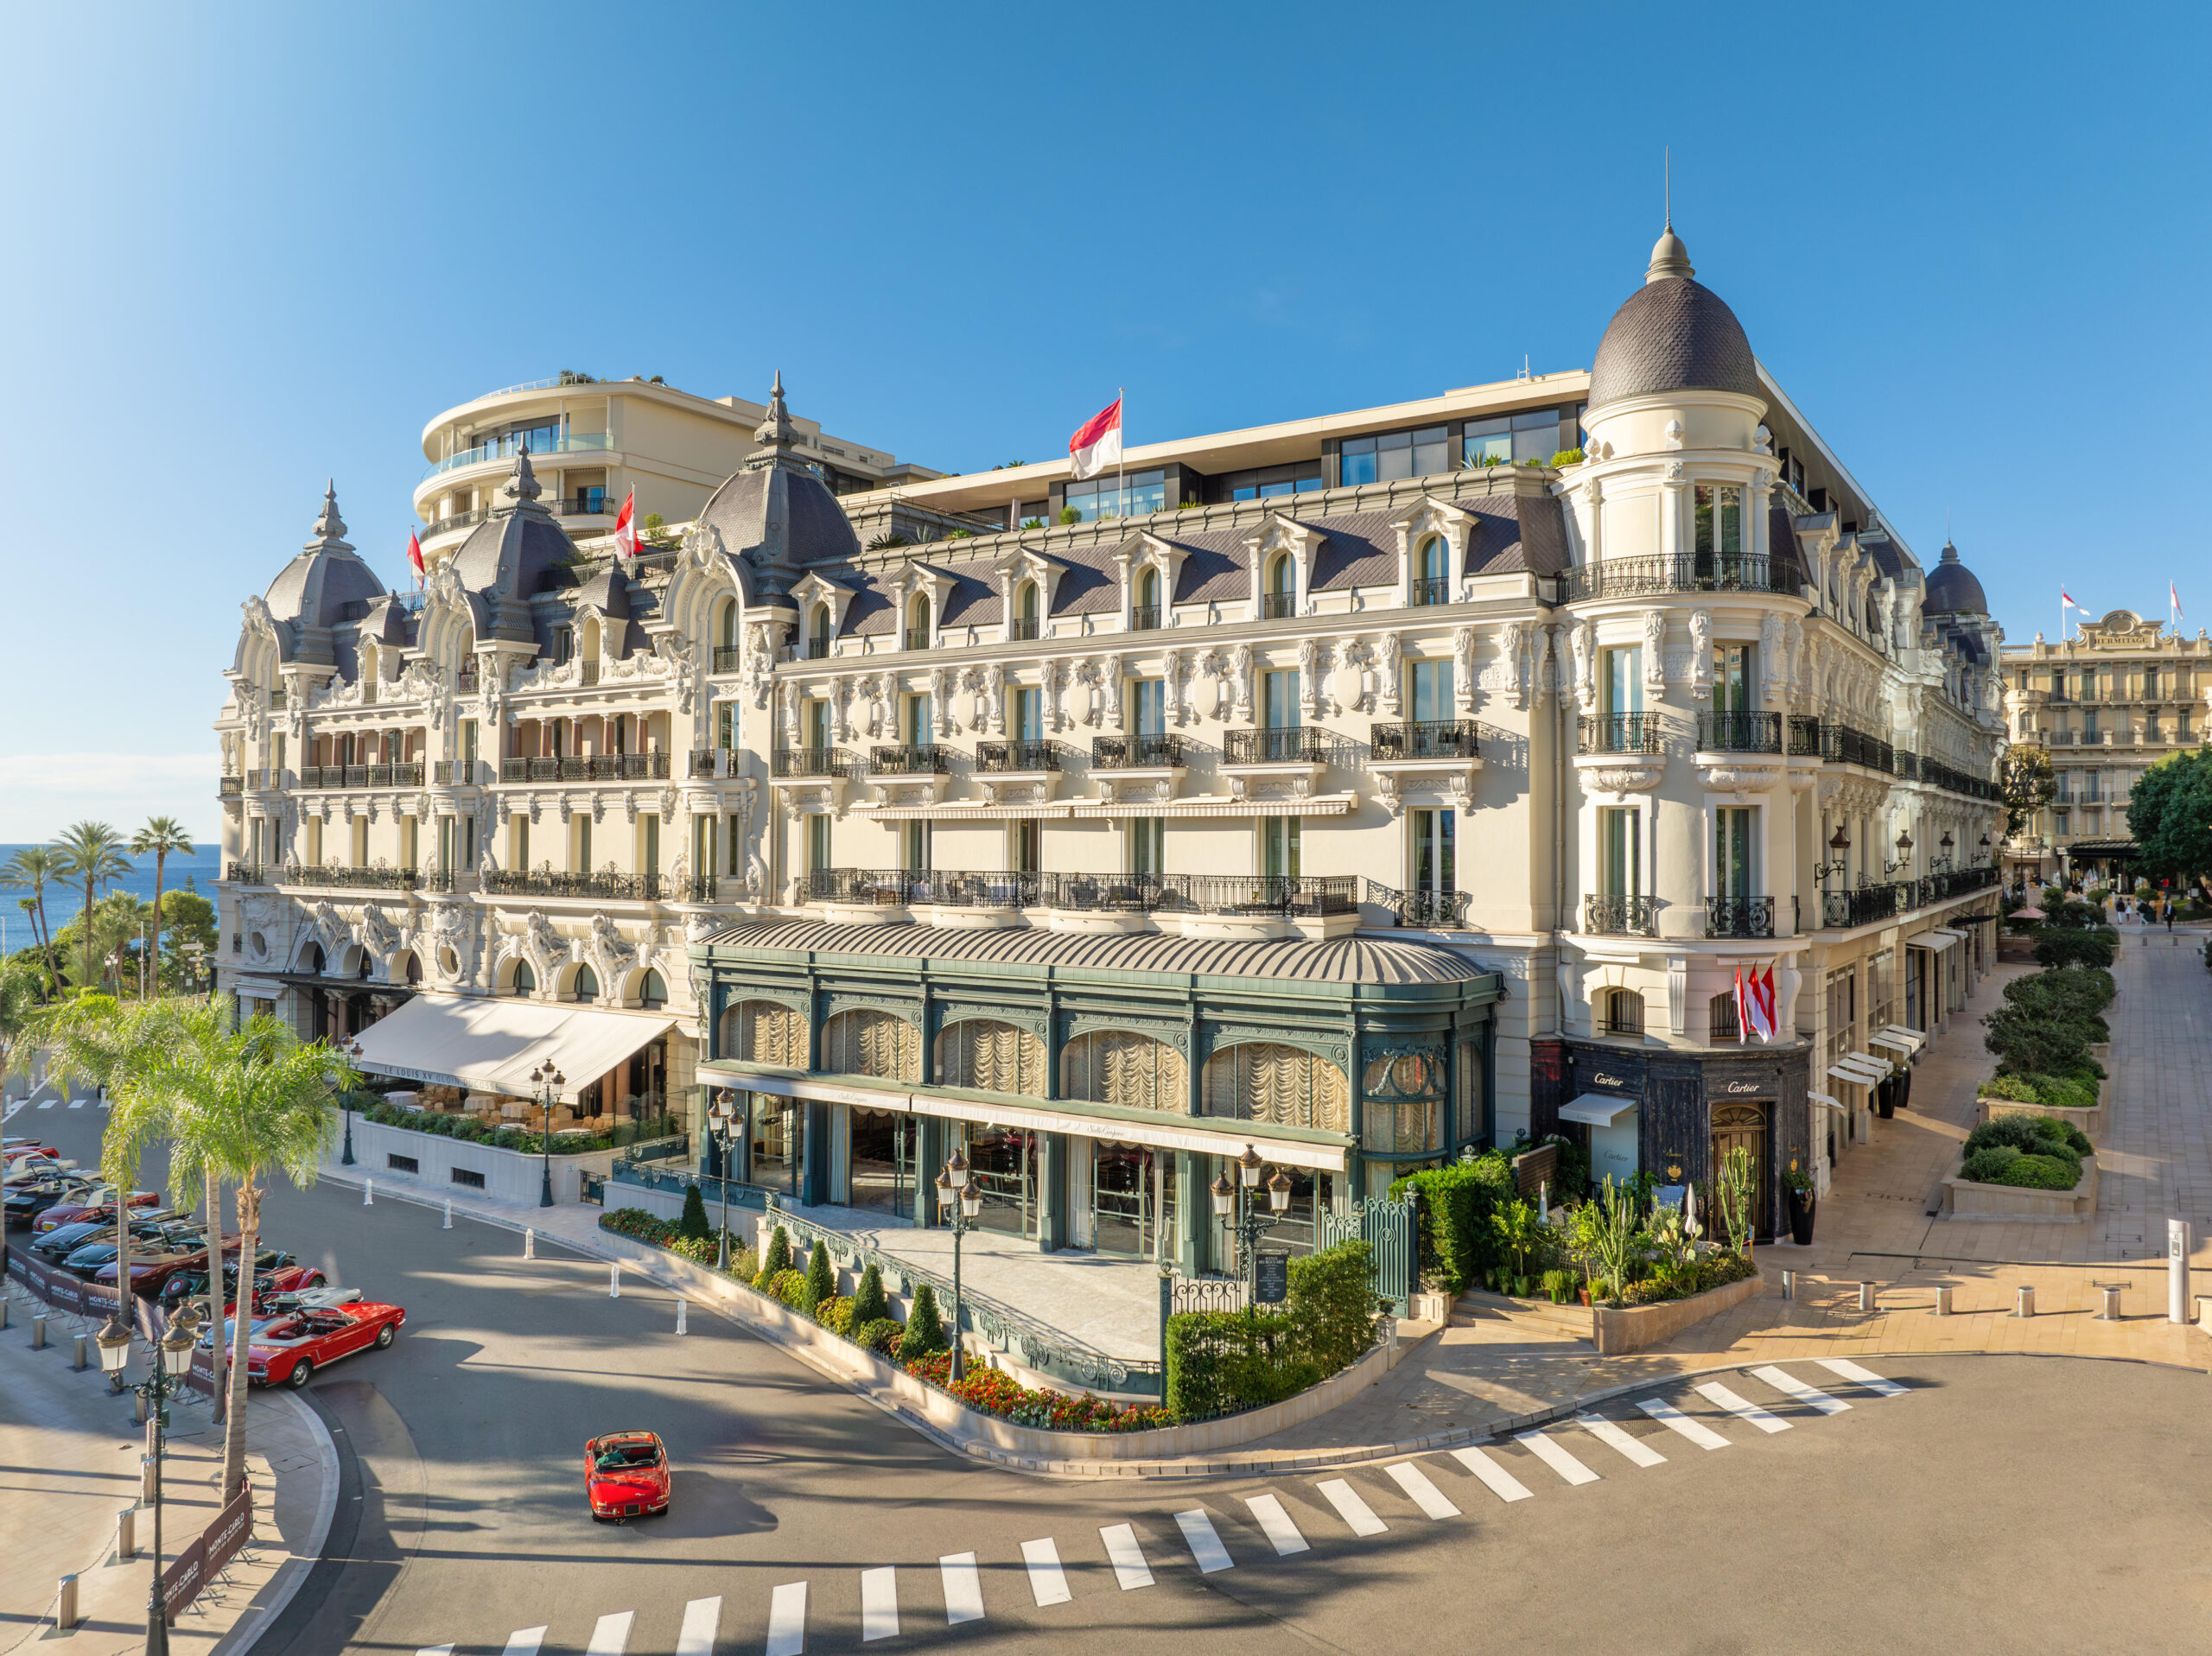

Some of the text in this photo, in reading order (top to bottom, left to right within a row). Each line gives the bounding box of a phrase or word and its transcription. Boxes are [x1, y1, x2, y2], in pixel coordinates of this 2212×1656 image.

[385, 1065, 393, 1074] LE
[397, 1067, 419, 1079] LOUIS
[1594, 1072, 1624, 1087] Cartier
[1727, 1081, 1760, 1094] Cartier
[1604, 1149, 1630, 1162] Cartier
[88, 1295, 120, 1307] MONTE-CAR
[192, 1363, 215, 1379] MONTE-C
[209, 1512, 245, 1555] MONTE-CARLO
